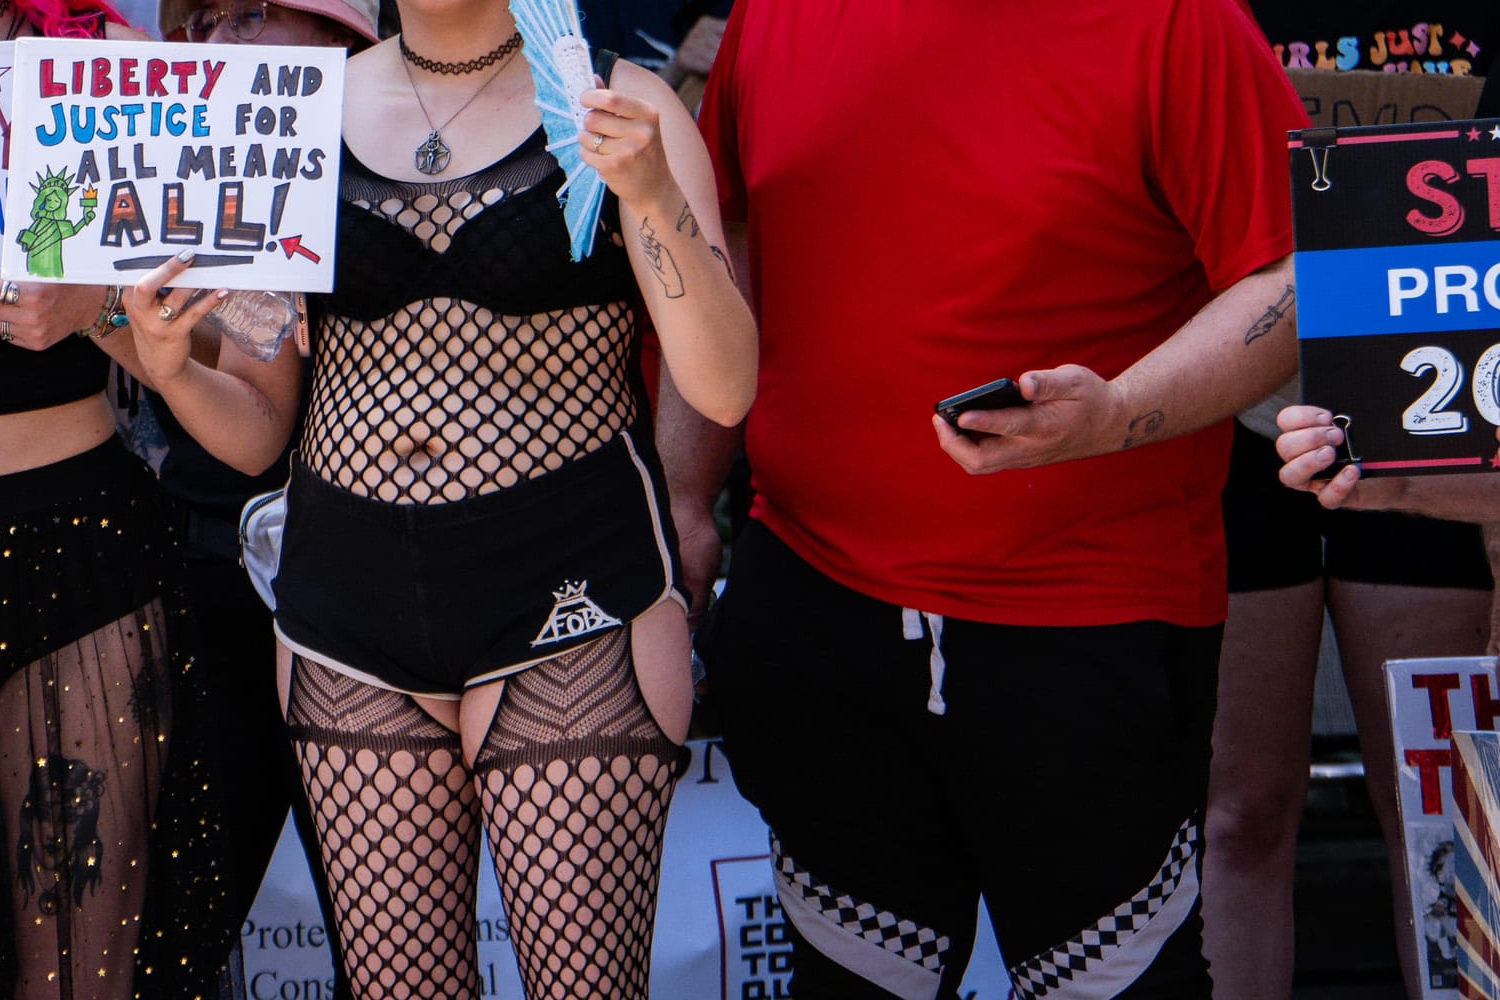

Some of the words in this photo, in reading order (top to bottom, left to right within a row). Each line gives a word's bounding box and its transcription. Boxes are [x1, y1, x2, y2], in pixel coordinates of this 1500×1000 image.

[1369, 22, 1444, 66] JUST
[39, 57, 227, 100] LIBERTY
[250, 63, 323, 97] AND
[35, 102, 211, 147] JUSTICE
[235, 102, 298, 137] FOR
[75, 142, 158, 184] ALL
[176, 143, 327, 181] MEANS
[100, 180, 291, 253] ALL!
[550, 606, 601, 641] FOB
